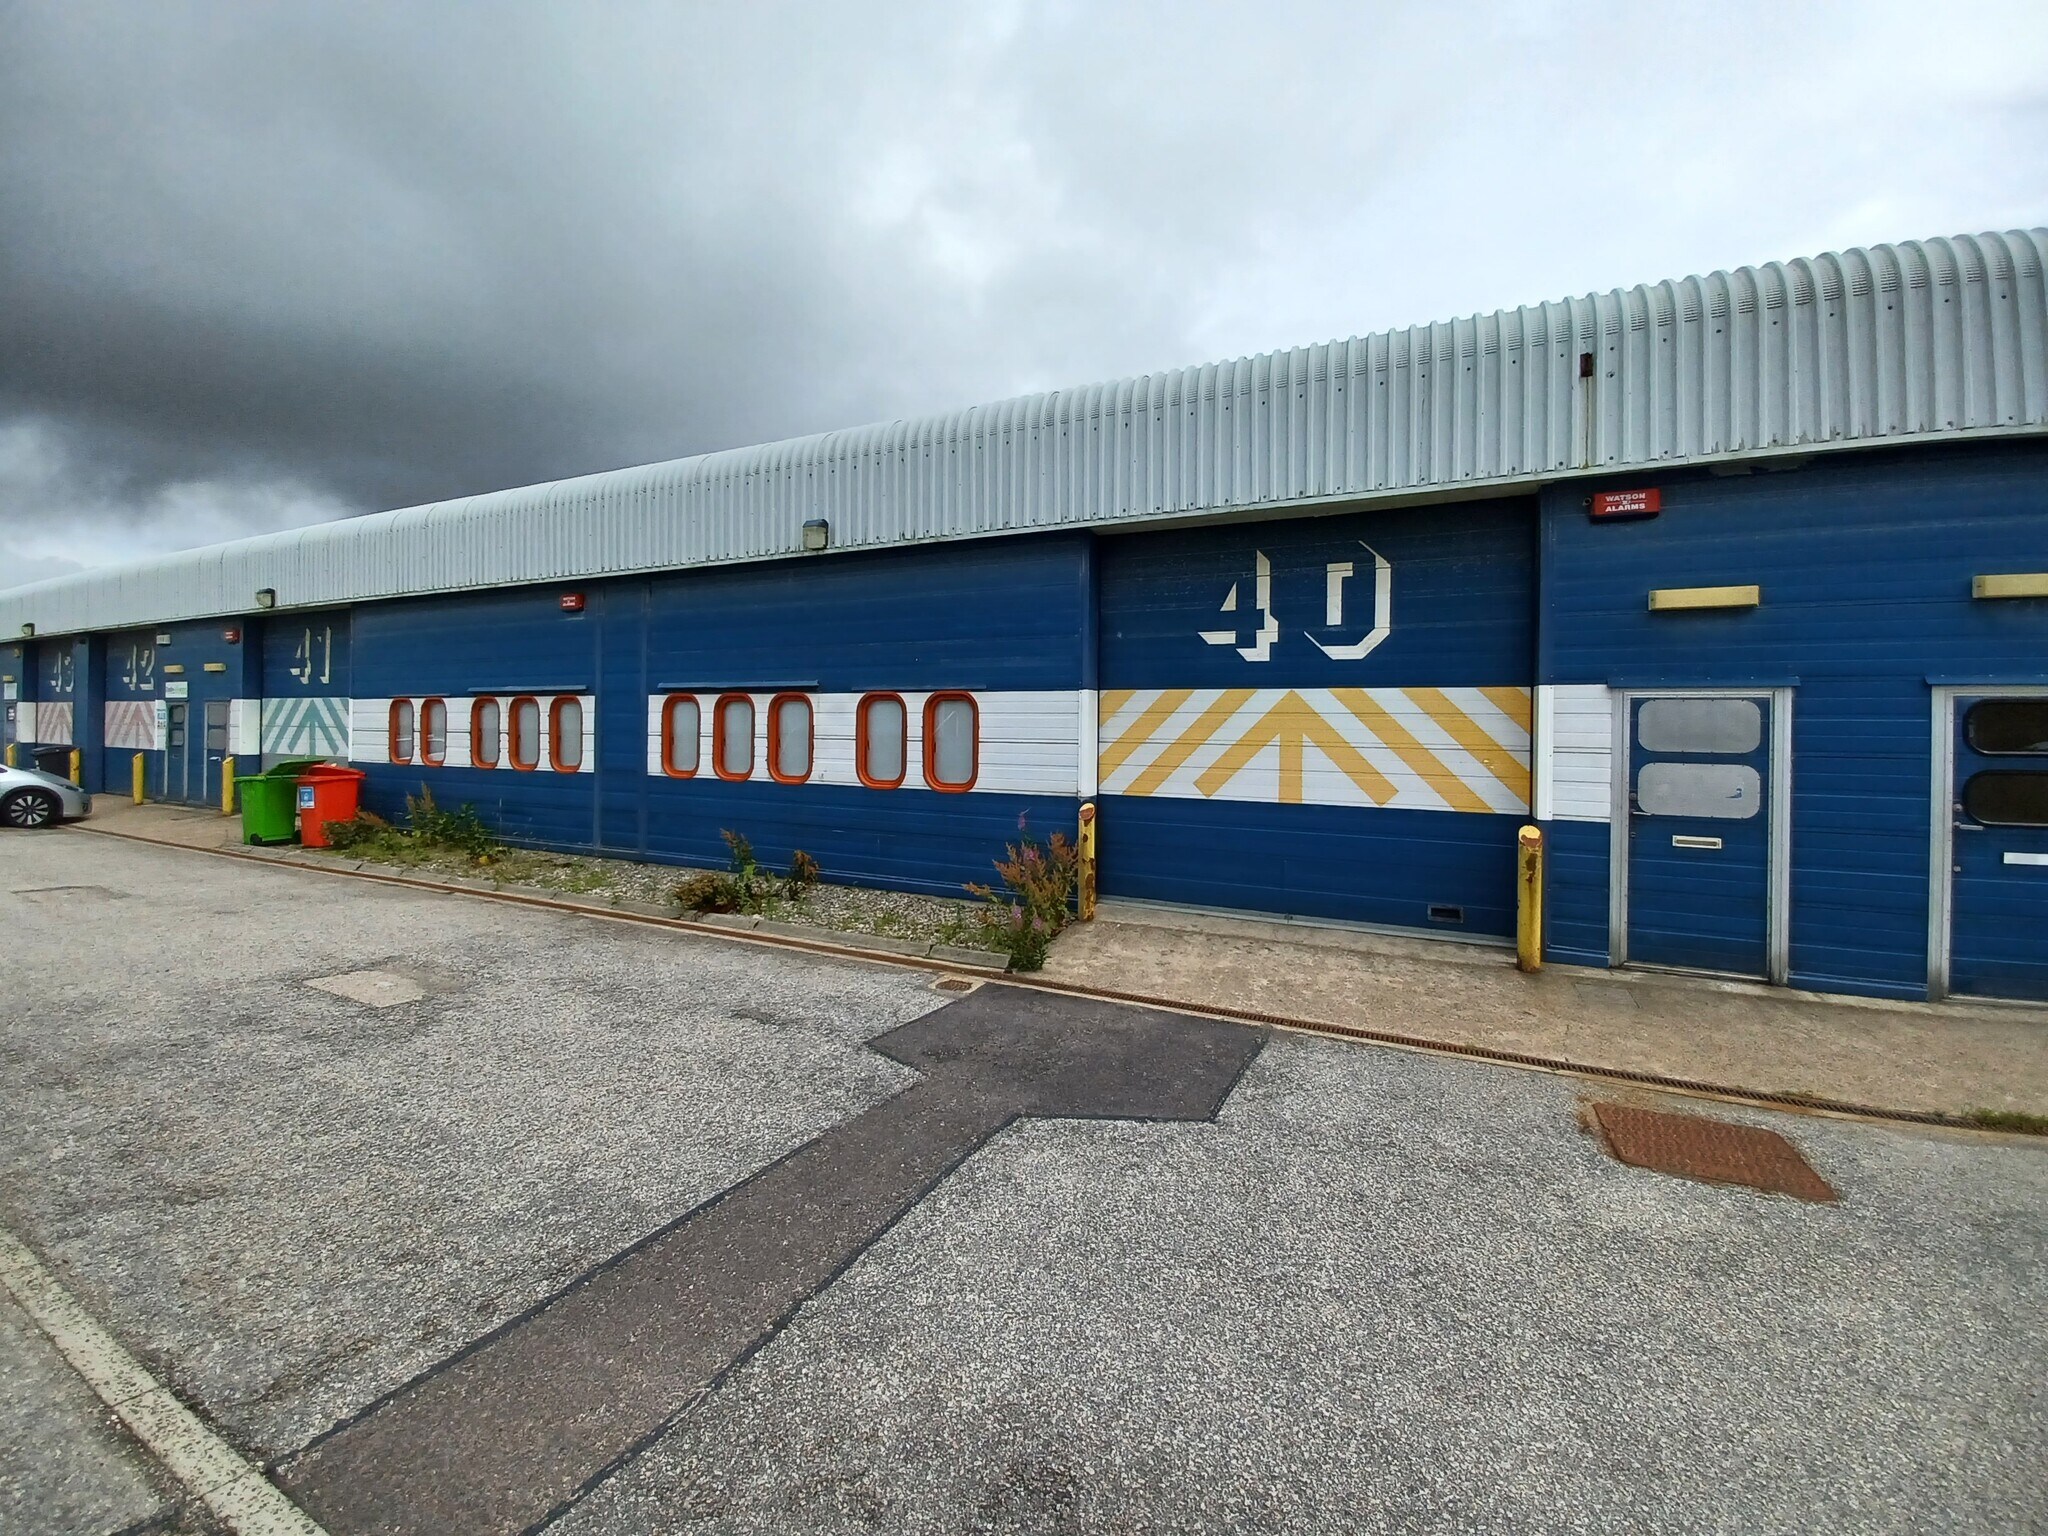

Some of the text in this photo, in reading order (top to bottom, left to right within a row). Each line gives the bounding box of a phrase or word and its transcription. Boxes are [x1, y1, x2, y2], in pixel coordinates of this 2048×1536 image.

[1605, 492, 1646, 502] WATSON
[1605, 502, 1646, 512] ALARMS
[1197, 540, 1391, 662] 40
[122, 644, 154, 691] 42
[289, 626, 332, 684] 41
